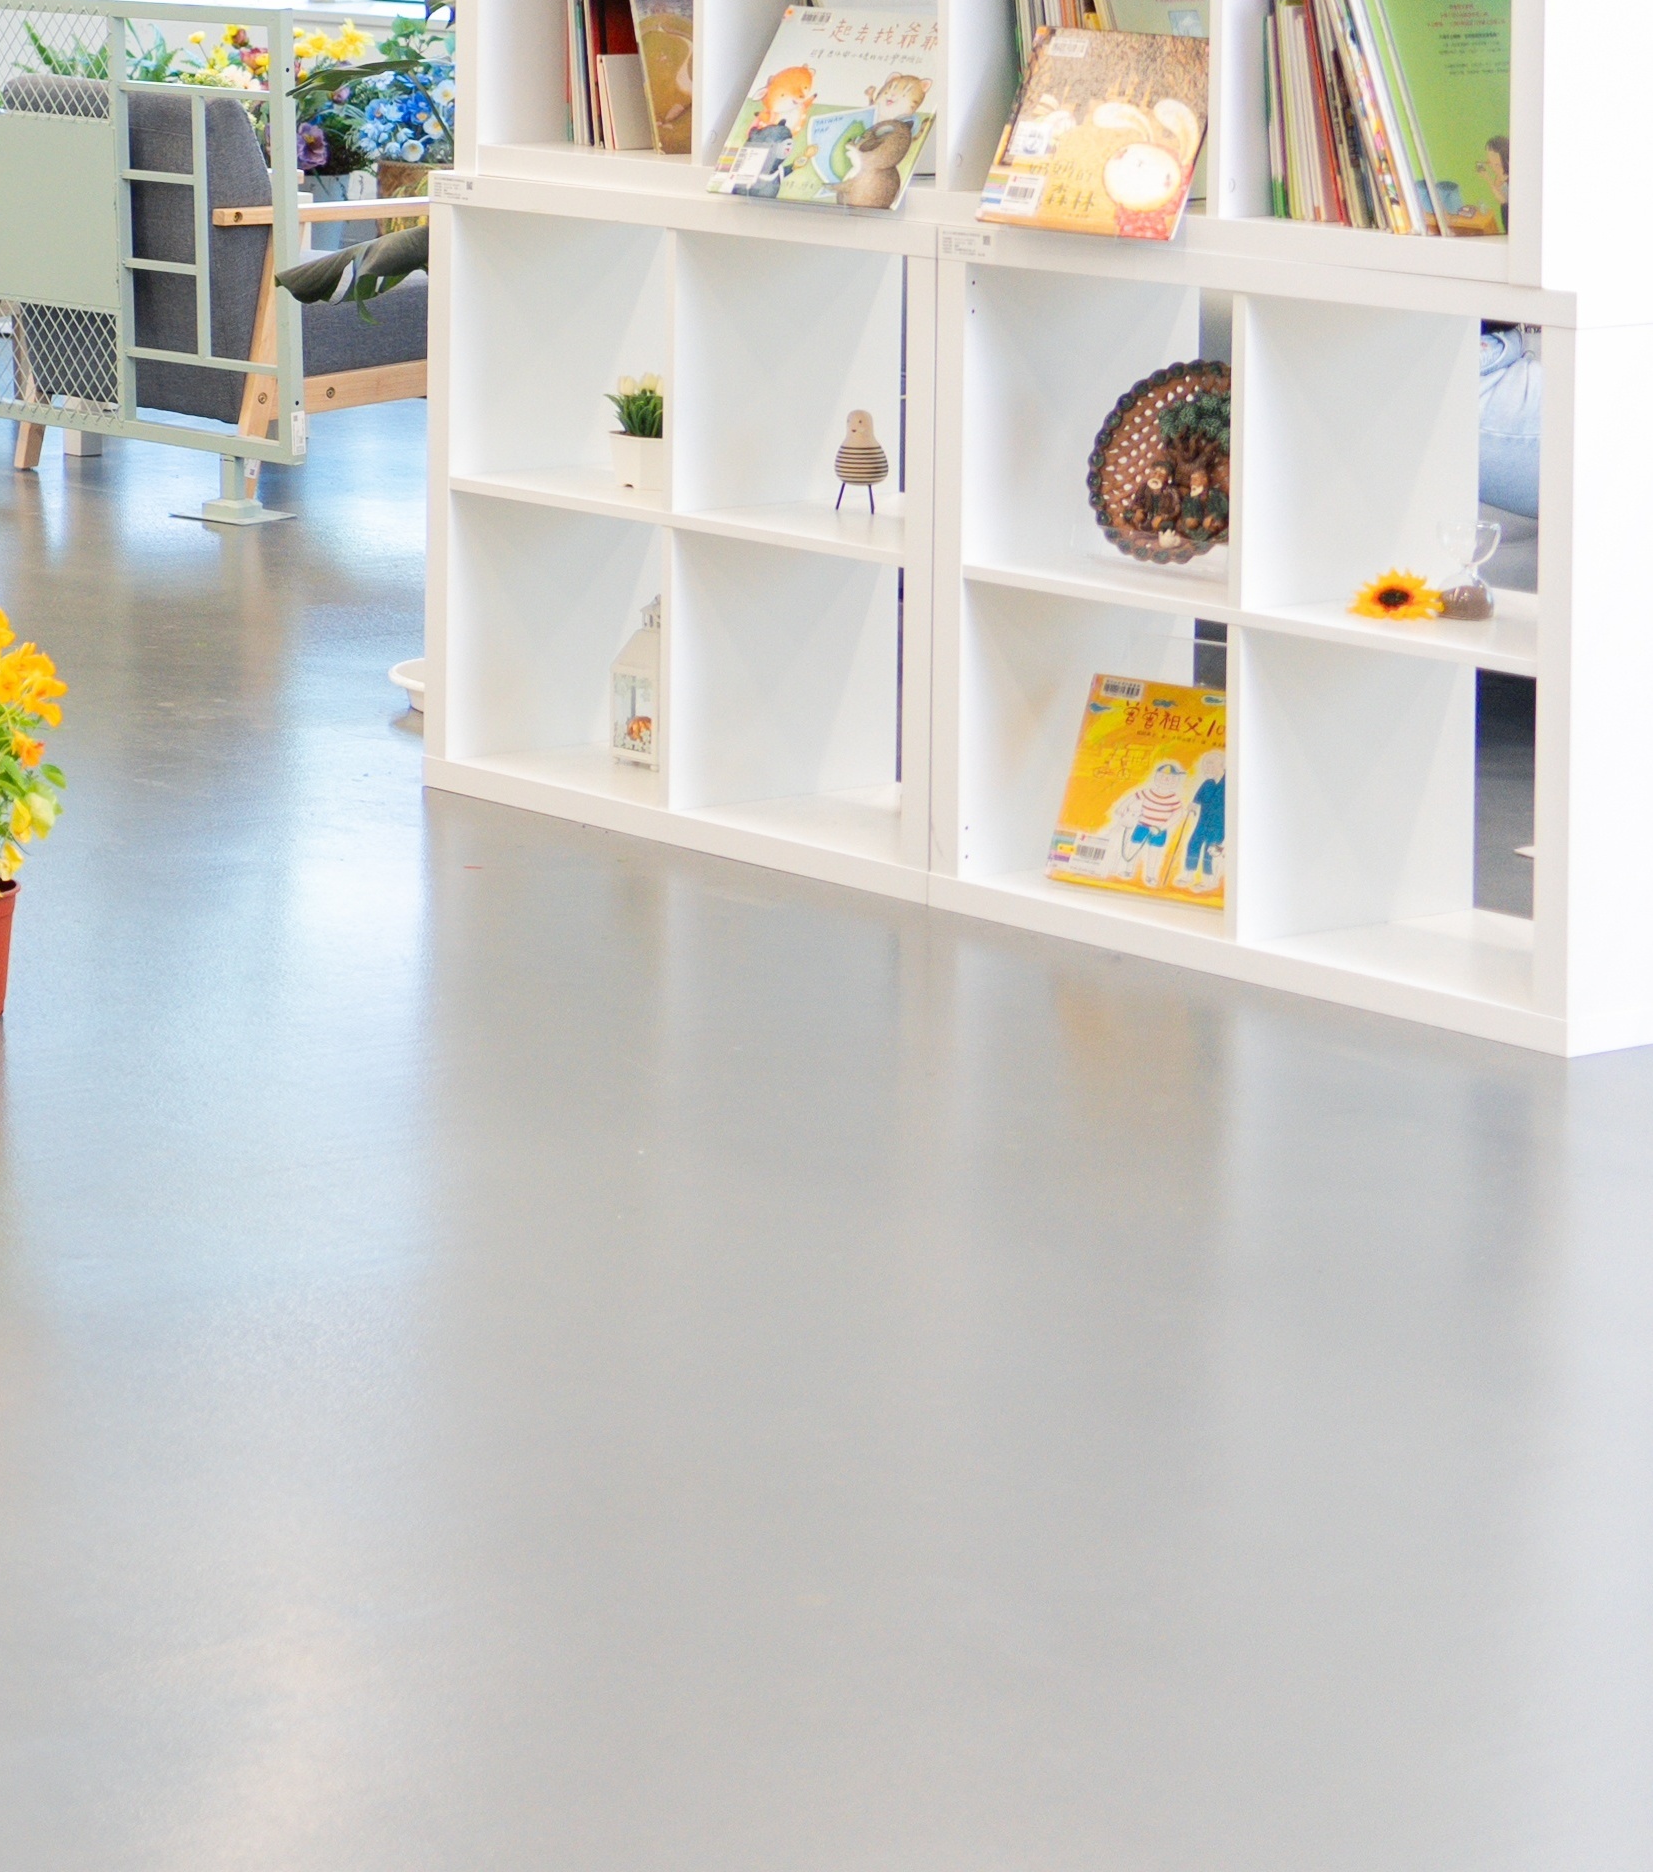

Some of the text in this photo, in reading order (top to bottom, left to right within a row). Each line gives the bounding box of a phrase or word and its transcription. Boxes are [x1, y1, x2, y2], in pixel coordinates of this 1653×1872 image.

[812, 18, 938, 51] 一起去找爺爺
